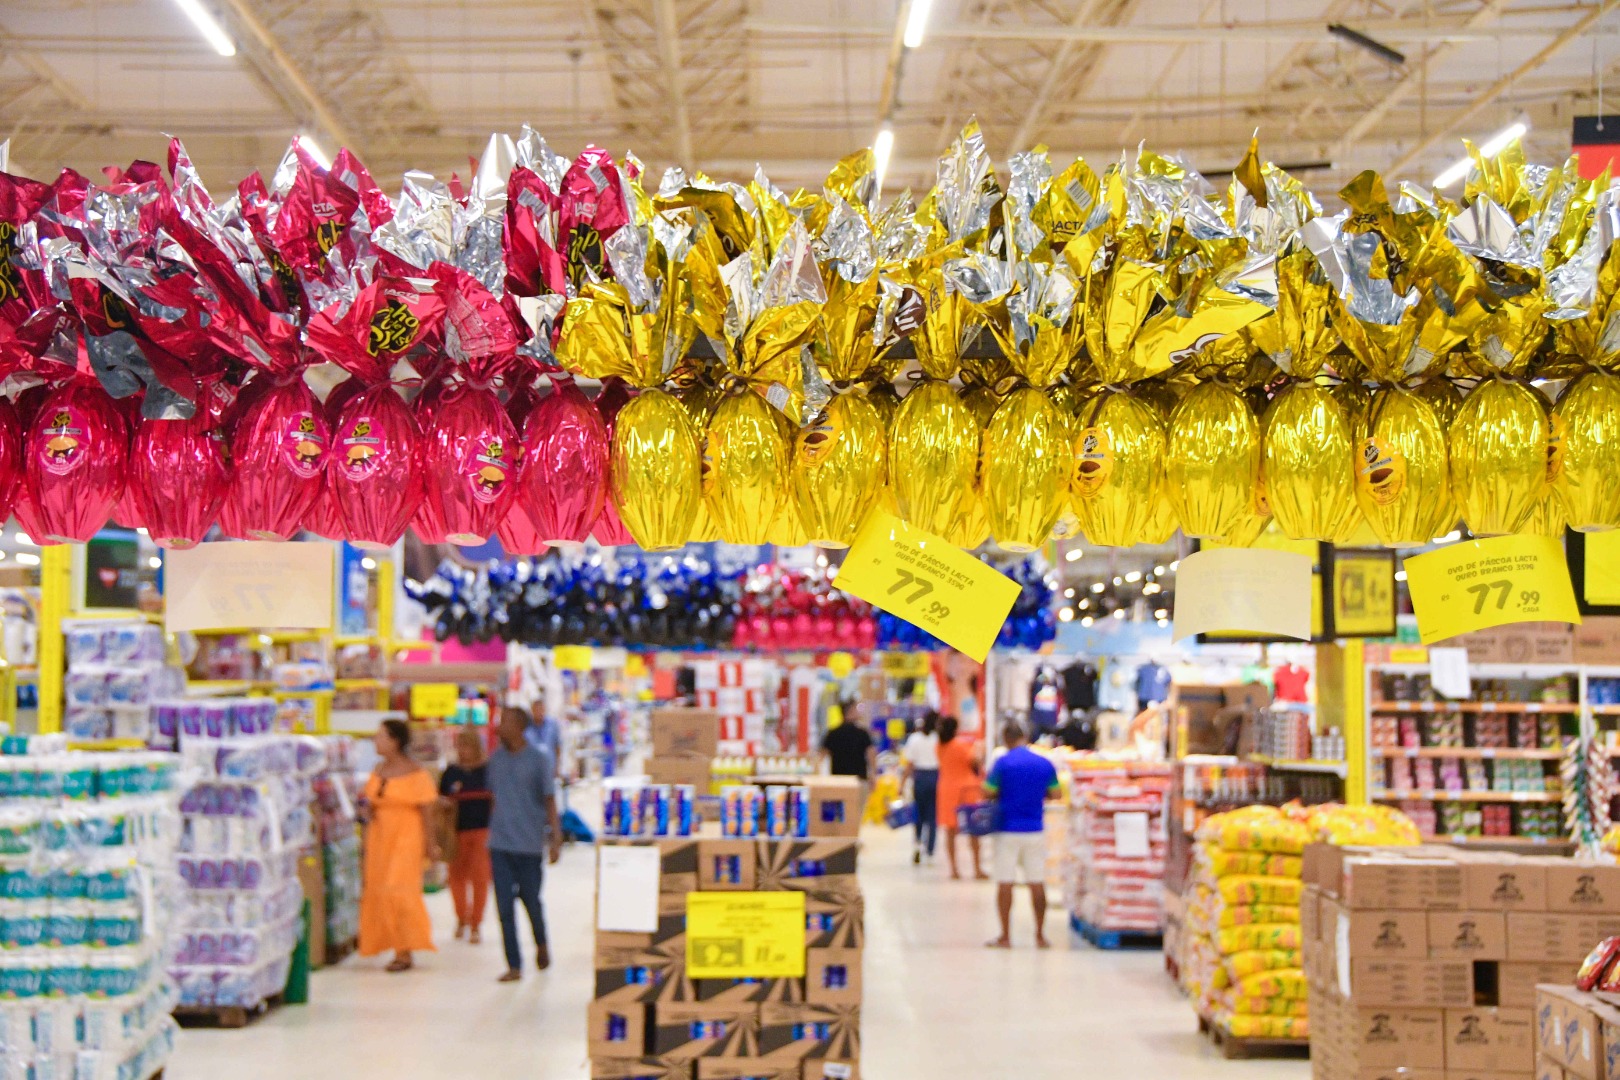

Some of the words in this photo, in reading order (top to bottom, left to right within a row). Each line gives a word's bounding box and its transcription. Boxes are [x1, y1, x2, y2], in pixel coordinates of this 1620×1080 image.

[312, 203, 337, 216] CTA
[894, 541, 910, 552] OVO
[910, 548, 922, 557] DE
[951, 569, 974, 586] LACTA
[896, 552, 915, 564] OURO
[916, 560, 946, 580] BRANCO
[1447, 565, 1464, 576] OVO
[1466, 562, 1476, 571] DE
[1514, 554, 1538, 564] LACTA
[1456, 570, 1478, 582] OURO
[1480, 564, 1513, 576] BRANCO
[922, 614, 940, 626] CADA
